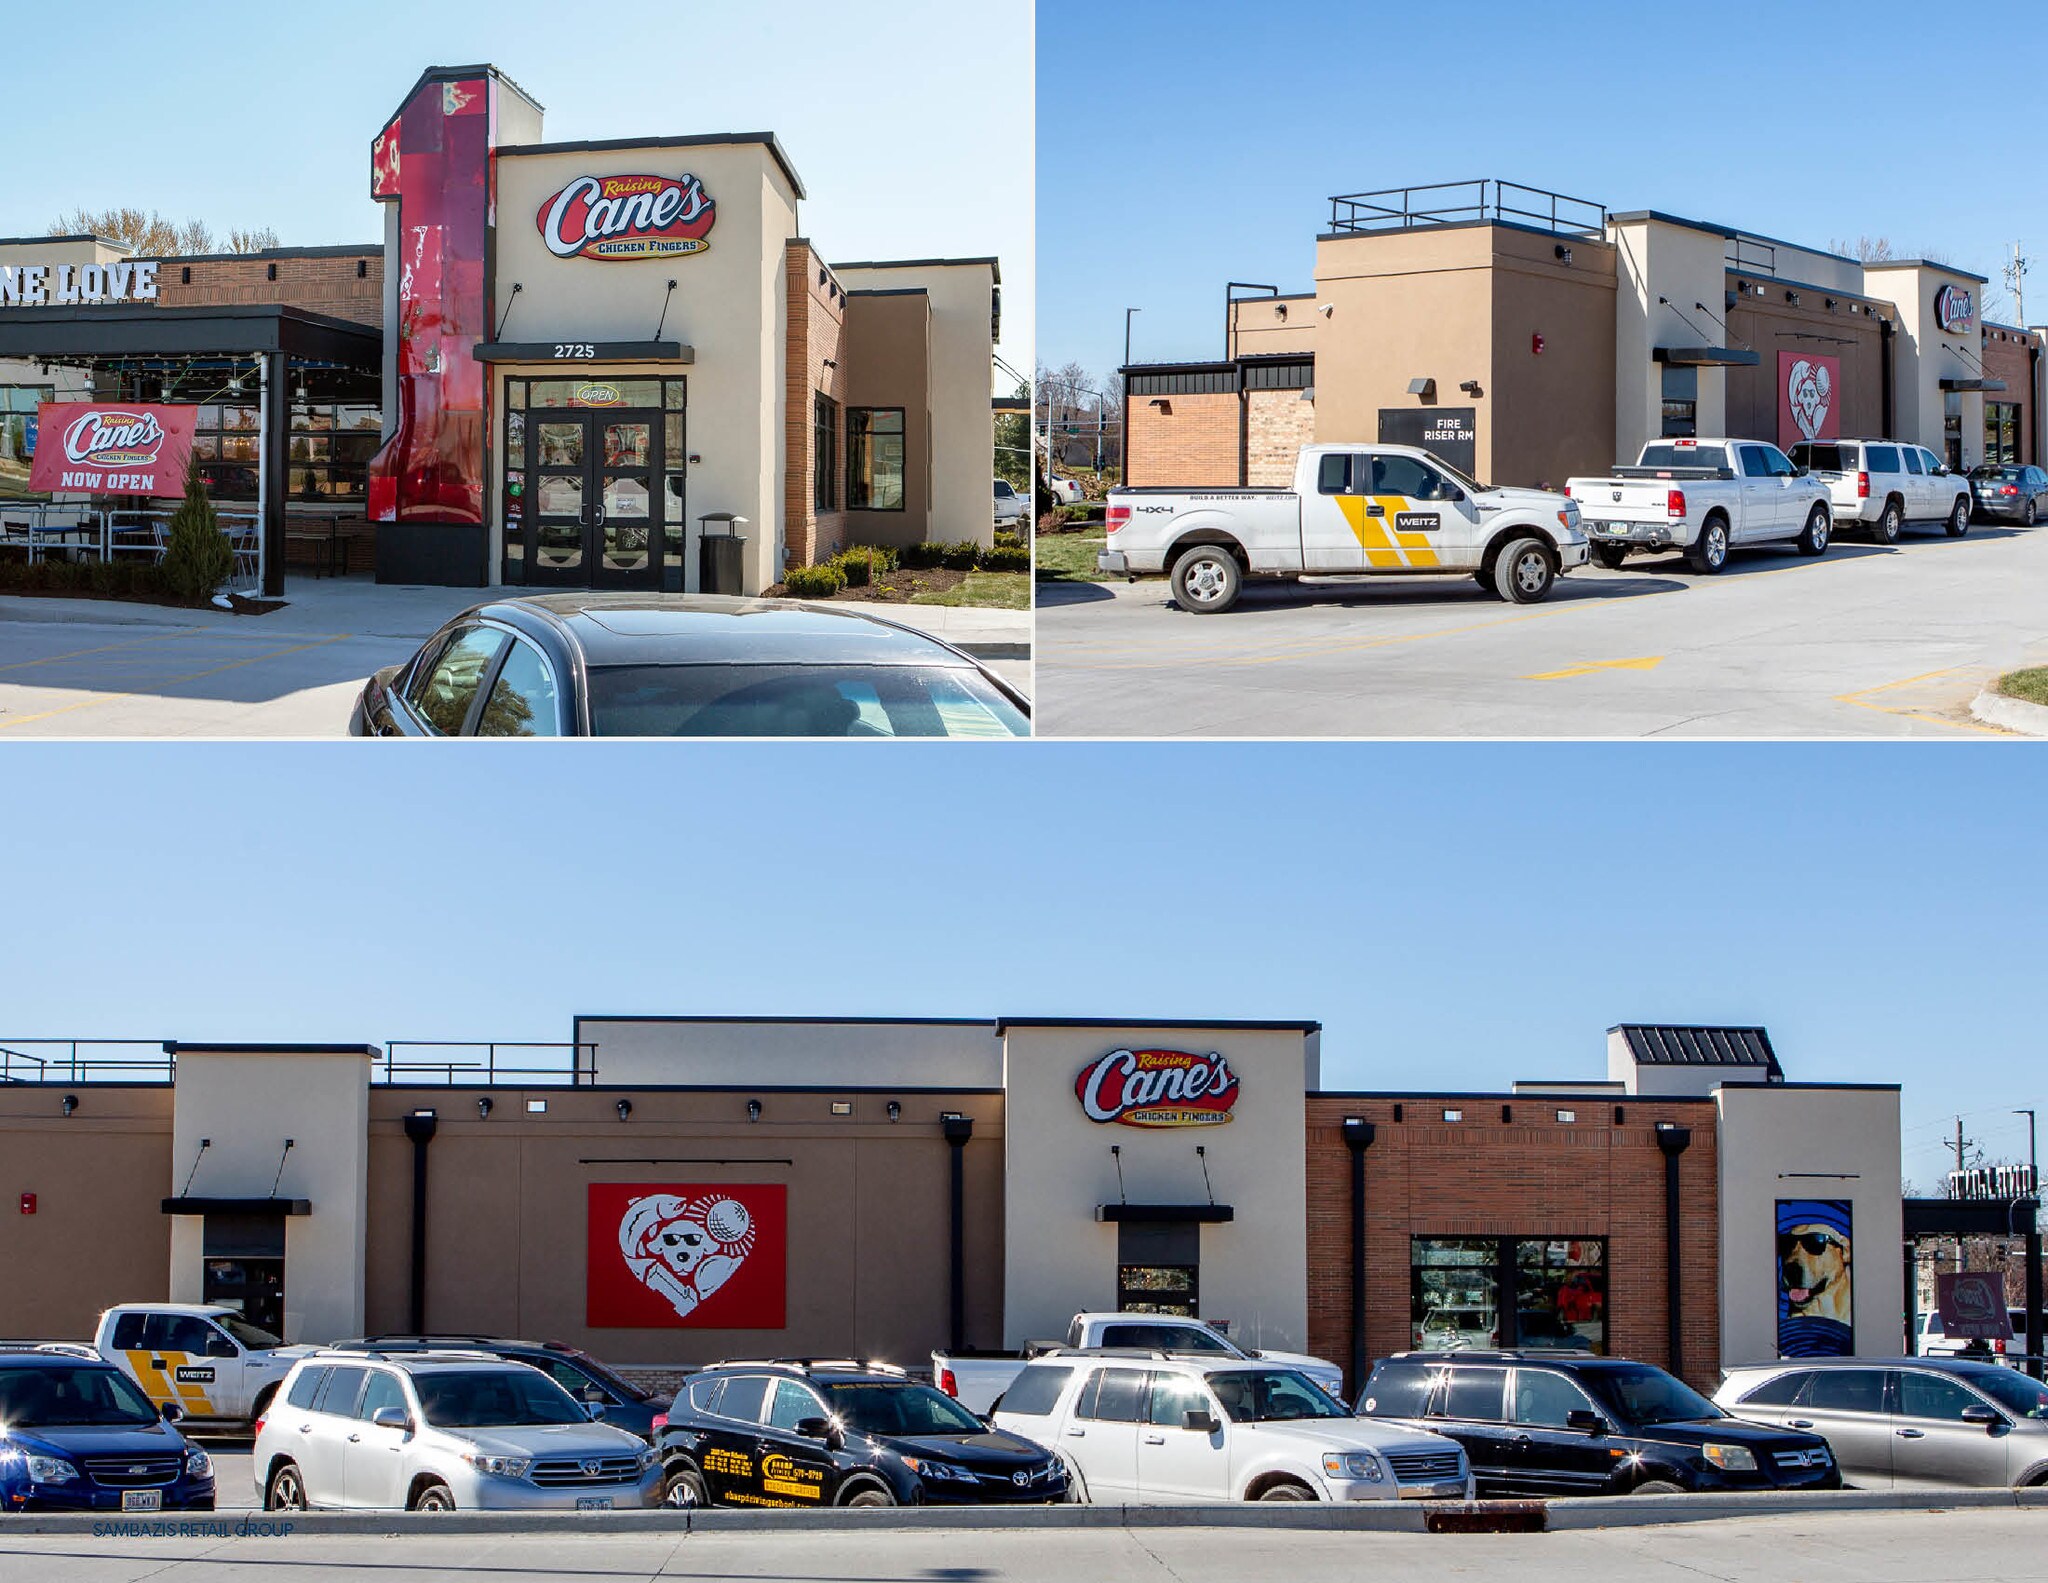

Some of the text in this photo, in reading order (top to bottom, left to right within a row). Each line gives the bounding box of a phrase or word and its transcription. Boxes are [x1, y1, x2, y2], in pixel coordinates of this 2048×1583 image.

[603, 178, 663, 197] Raising
[544, 173, 716, 258] Cane's
[597, 240, 697, 254] CHICKEN FINGERS
[56, 261, 158, 301] LOVE
[554, 344, 595, 359] 2725
[580, 389, 616, 402] OPEN
[103, 415, 136, 427] Raising
[1436, 419, 1461, 429] FIRE
[67, 412, 165, 462] Cane's
[1424, 430, 1474, 440] RISER RM
[61, 471, 155, 490] NOW OPEN
[1399, 517, 1438, 526] WEITZ
[1138, 1053, 1192, 1069] Raising
[1084, 1049, 1237, 1121] Cane's
[1133, 1110, 1178, 1122] CHICKEN
[179, 1370, 214, 1379] WEITZ
